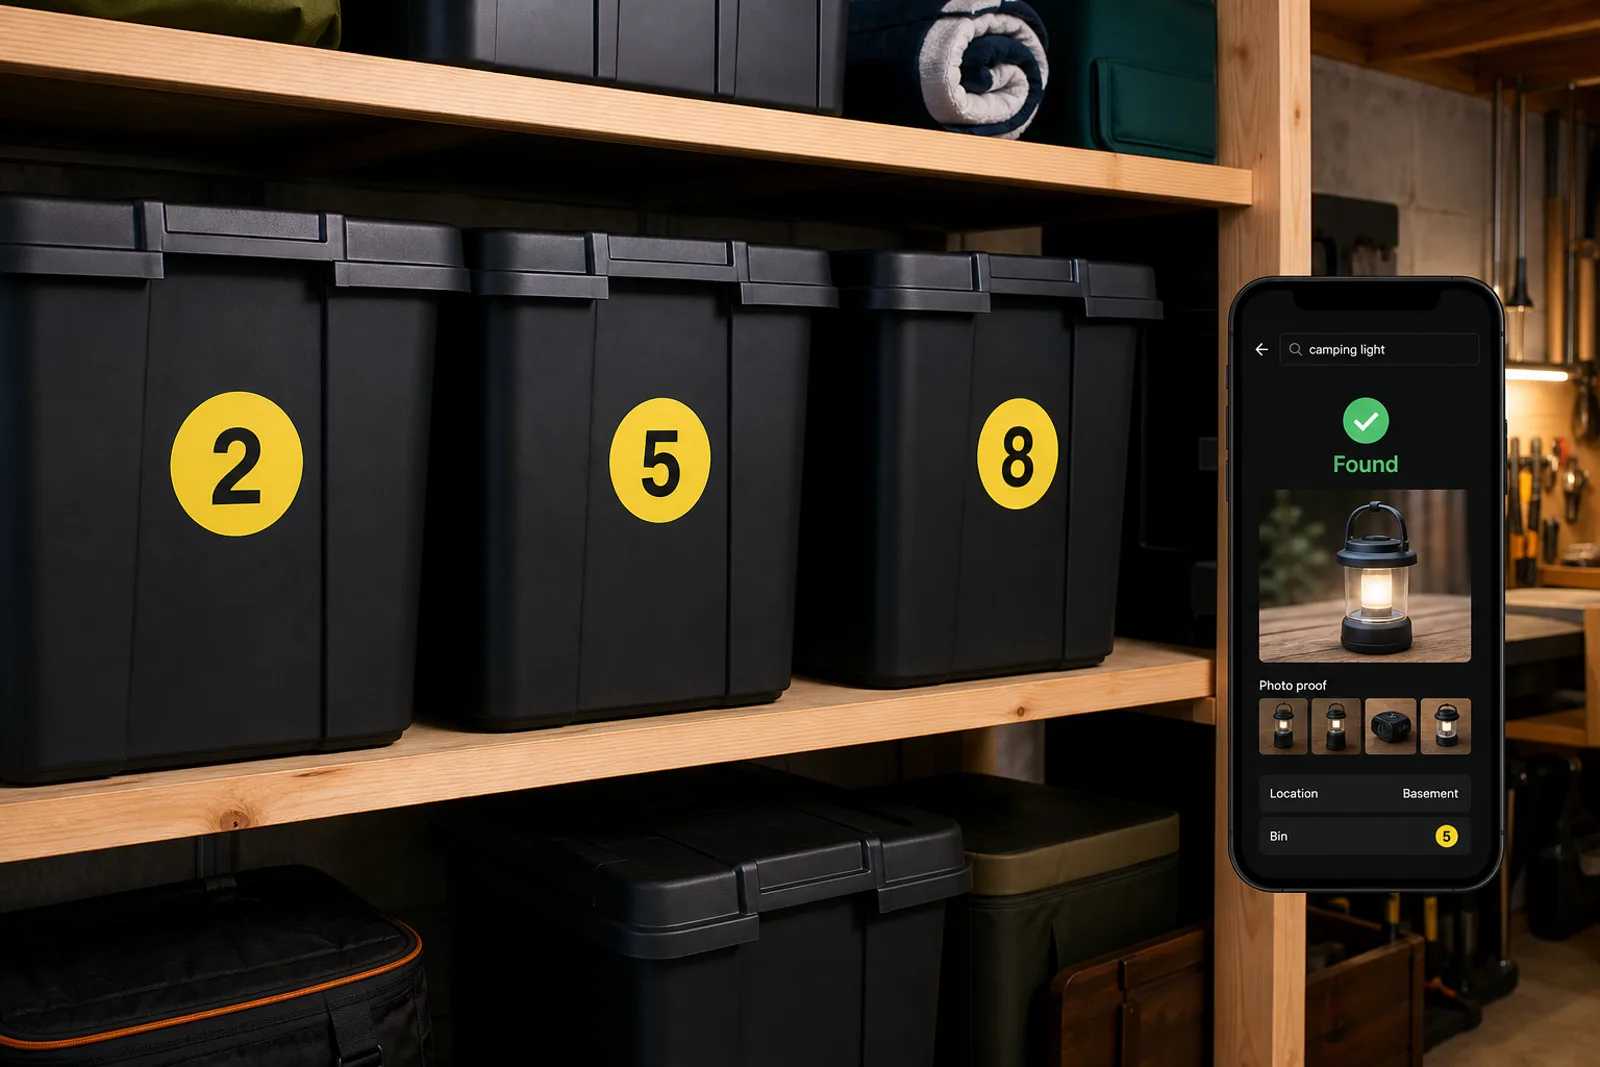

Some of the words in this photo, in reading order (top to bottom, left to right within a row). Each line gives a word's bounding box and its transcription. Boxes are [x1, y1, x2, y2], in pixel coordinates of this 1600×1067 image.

[1308, 344, 1358, 358] camping
[1360, 343, 1386, 358] light
[641, 429, 681, 498] 5
[1001, 425, 1034, 488] 8
[1333, 454, 1399, 473] Found
[210, 427, 262, 506] 2
[1259, 679, 1294, 691] Photo
[1296, 679, 1328, 693] proof
[1270, 788, 1319, 799] Location
[1402, 788, 1459, 799] Basement
[1270, 830, 1288, 842] Bin
[1442, 830, 1451, 843] 5
